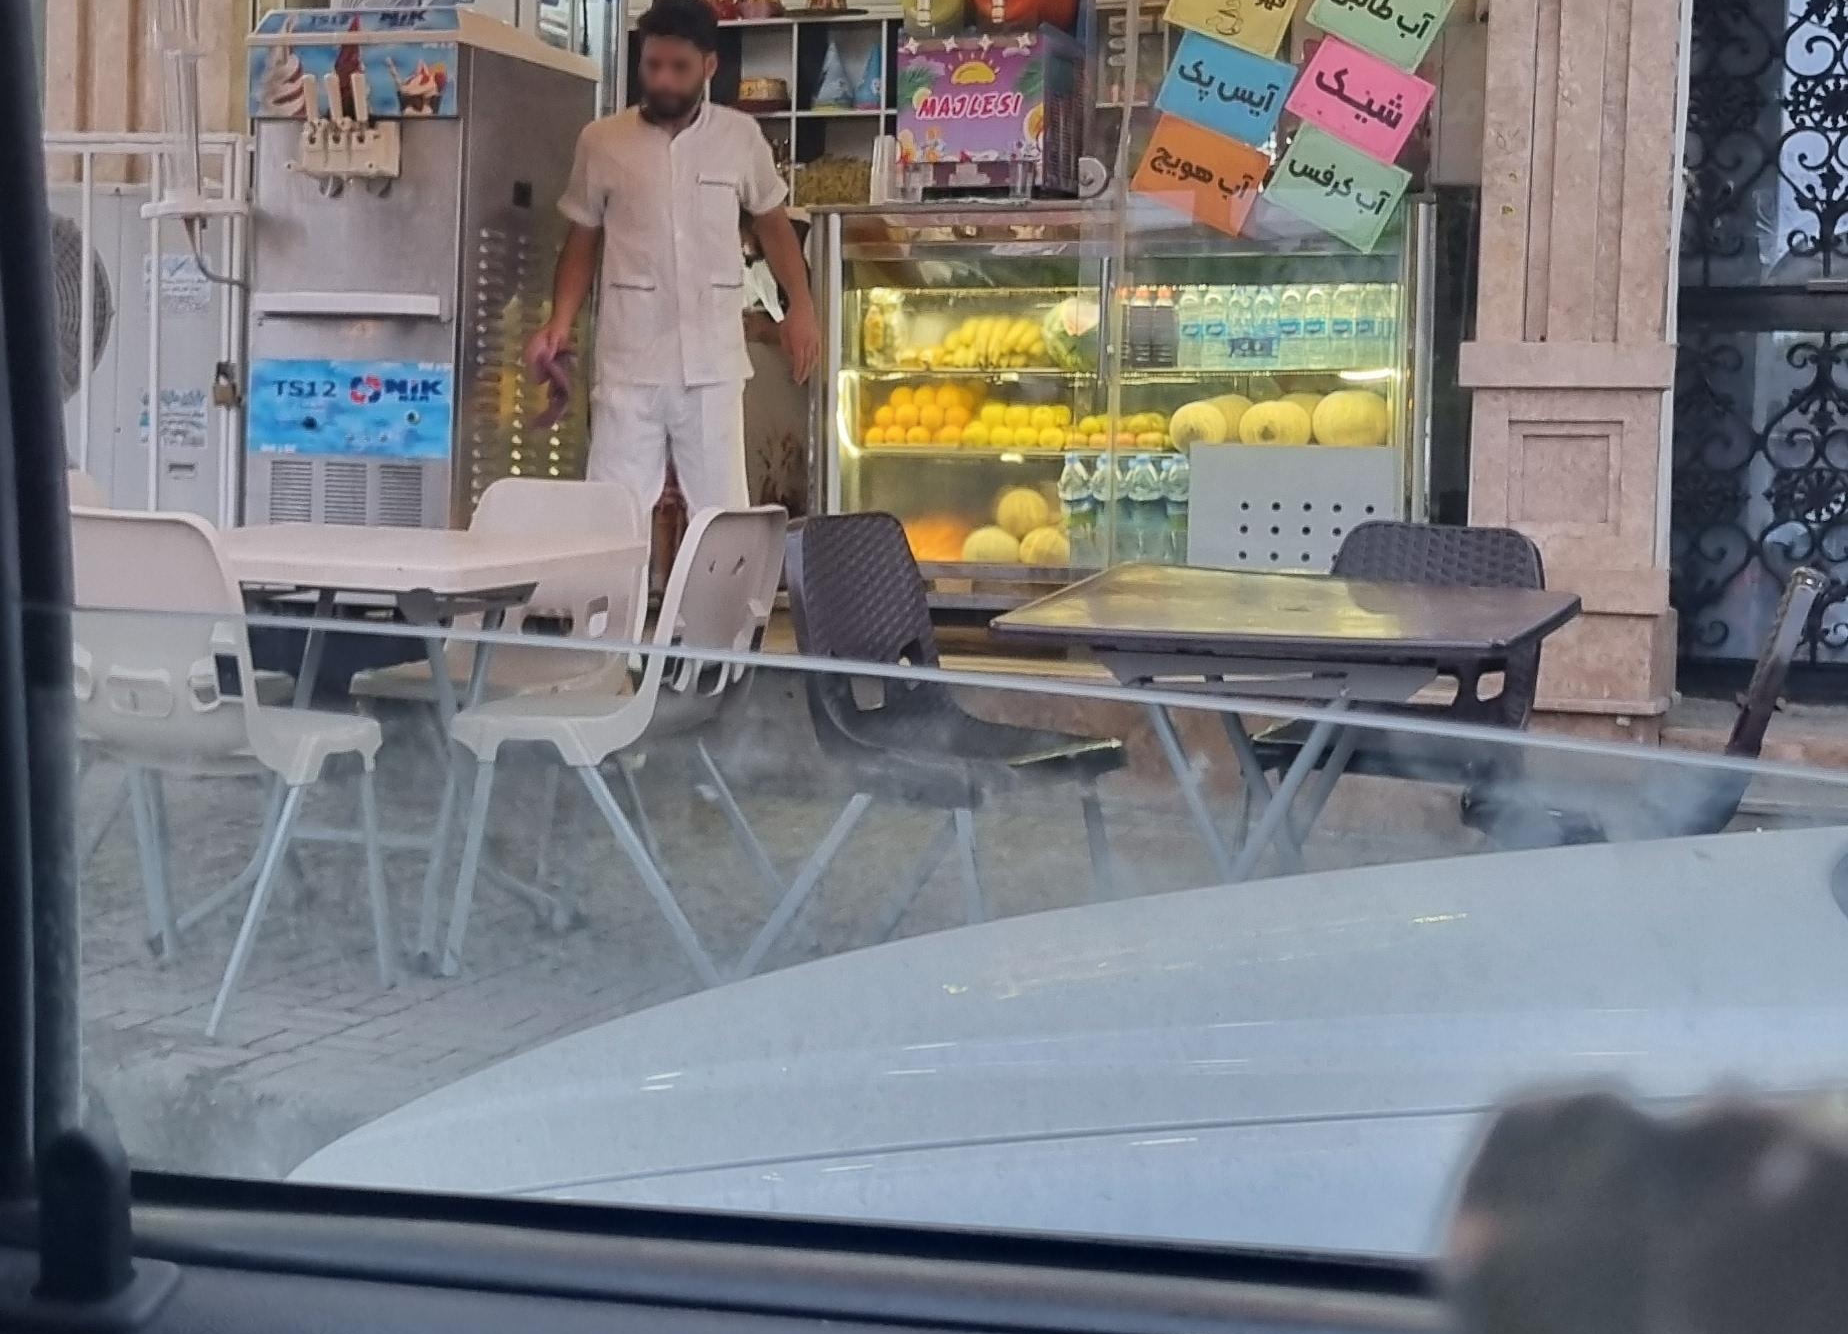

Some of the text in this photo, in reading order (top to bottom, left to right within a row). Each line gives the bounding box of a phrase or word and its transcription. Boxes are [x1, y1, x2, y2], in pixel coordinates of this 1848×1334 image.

[1396, 12, 1435, 39] آب
[917, 92, 1022, 118] MAJLESI
[1178, 60, 1280, 117] آیس پک
[1150, 147, 1254, 200] آب هویج
[1288, 159, 1391, 215] آب کرفس
[273, 380, 337, 398] TS12
